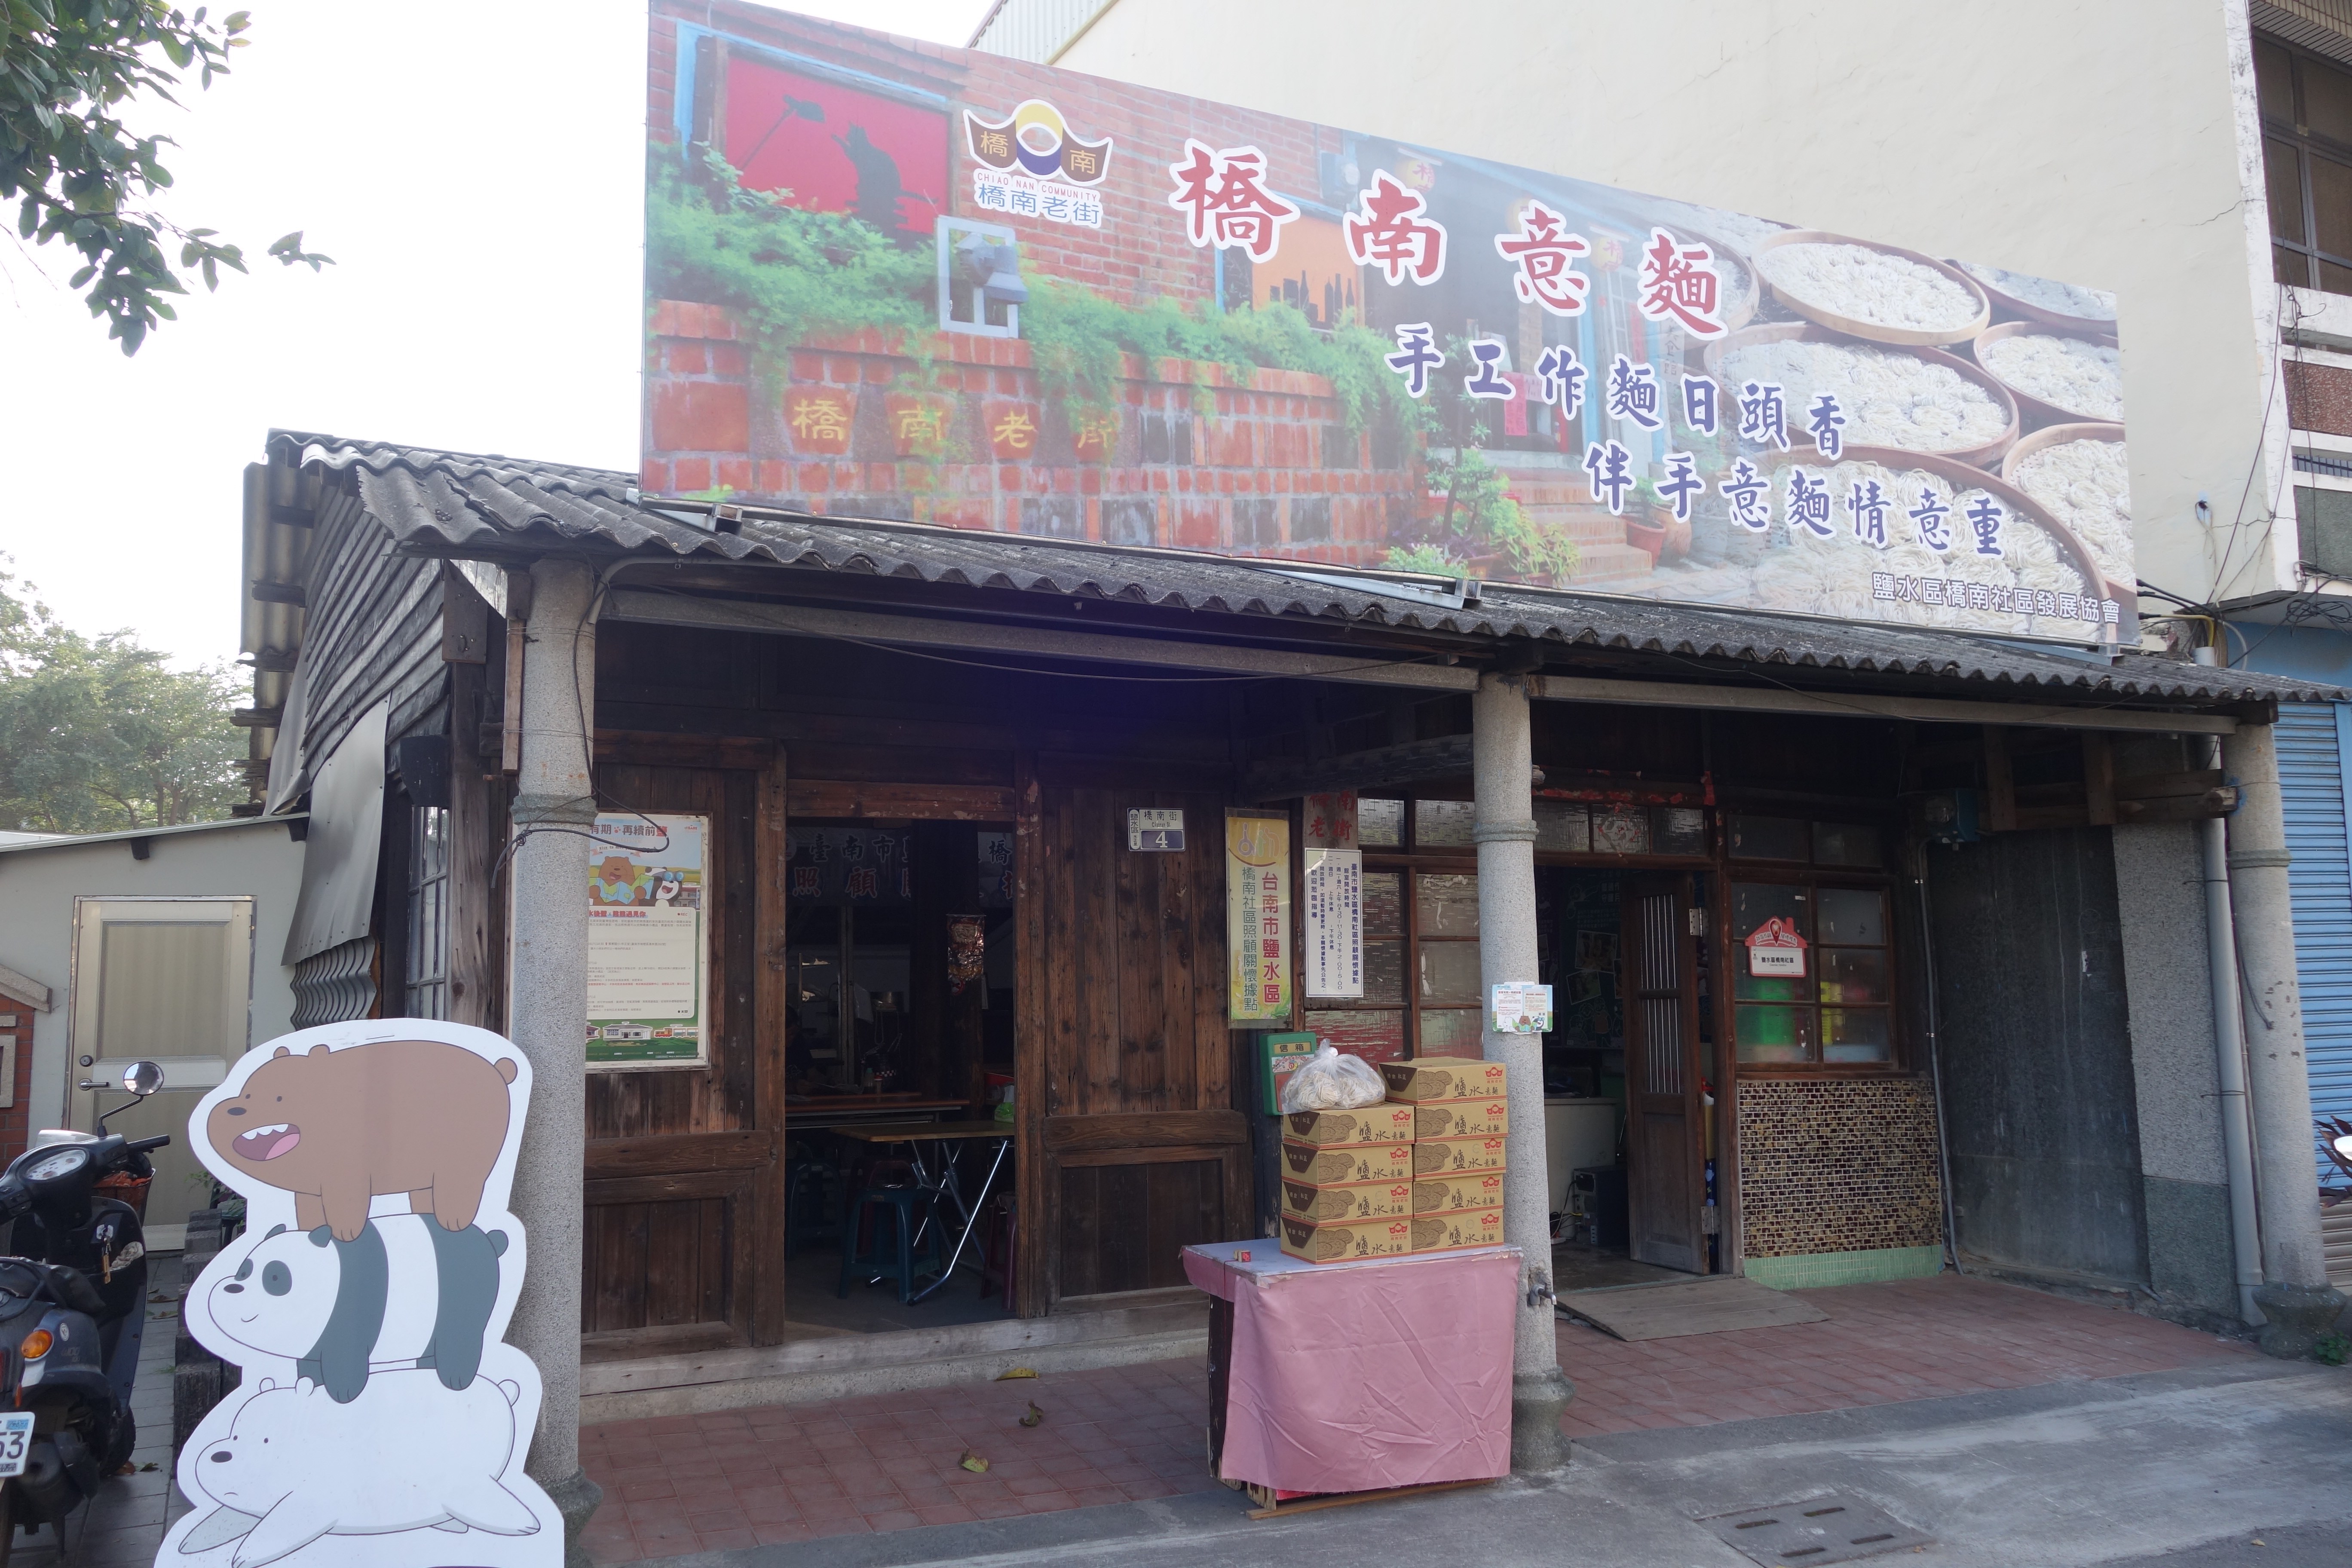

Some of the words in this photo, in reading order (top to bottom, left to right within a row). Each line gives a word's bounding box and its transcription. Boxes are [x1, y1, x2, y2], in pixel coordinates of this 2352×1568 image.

[980, 131, 1008, 157] 橋
[1070, 150, 1096, 174] 南
[978, 173, 1009, 185] CHIAO
[1016, 181, 1035, 190] NAN
[1042, 185, 1097, 202] COMMUNITY
[978, 183, 1099, 224] 橋南老街
[1176, 145, 1721, 333] 橋南意麵
[1388, 327, 1846, 456] 手工作麵日頭香
[1587, 444, 2003, 555] 伴手意麵情意重
[1872, 573, 2120, 624] 鹽水區橋南社區發展協會
[1130, 814, 1139, 833] 鹽水區
[1144, 811, 1177, 821] 橋南街
[1155, 831, 1168, 848] 4
[1242, 867, 1259, 1012] 橋南社區照顧關懷據點
[1262, 871, 1281, 1004] 台南市鹽水區
[1280, 1043, 1304, 1052] 信箱
